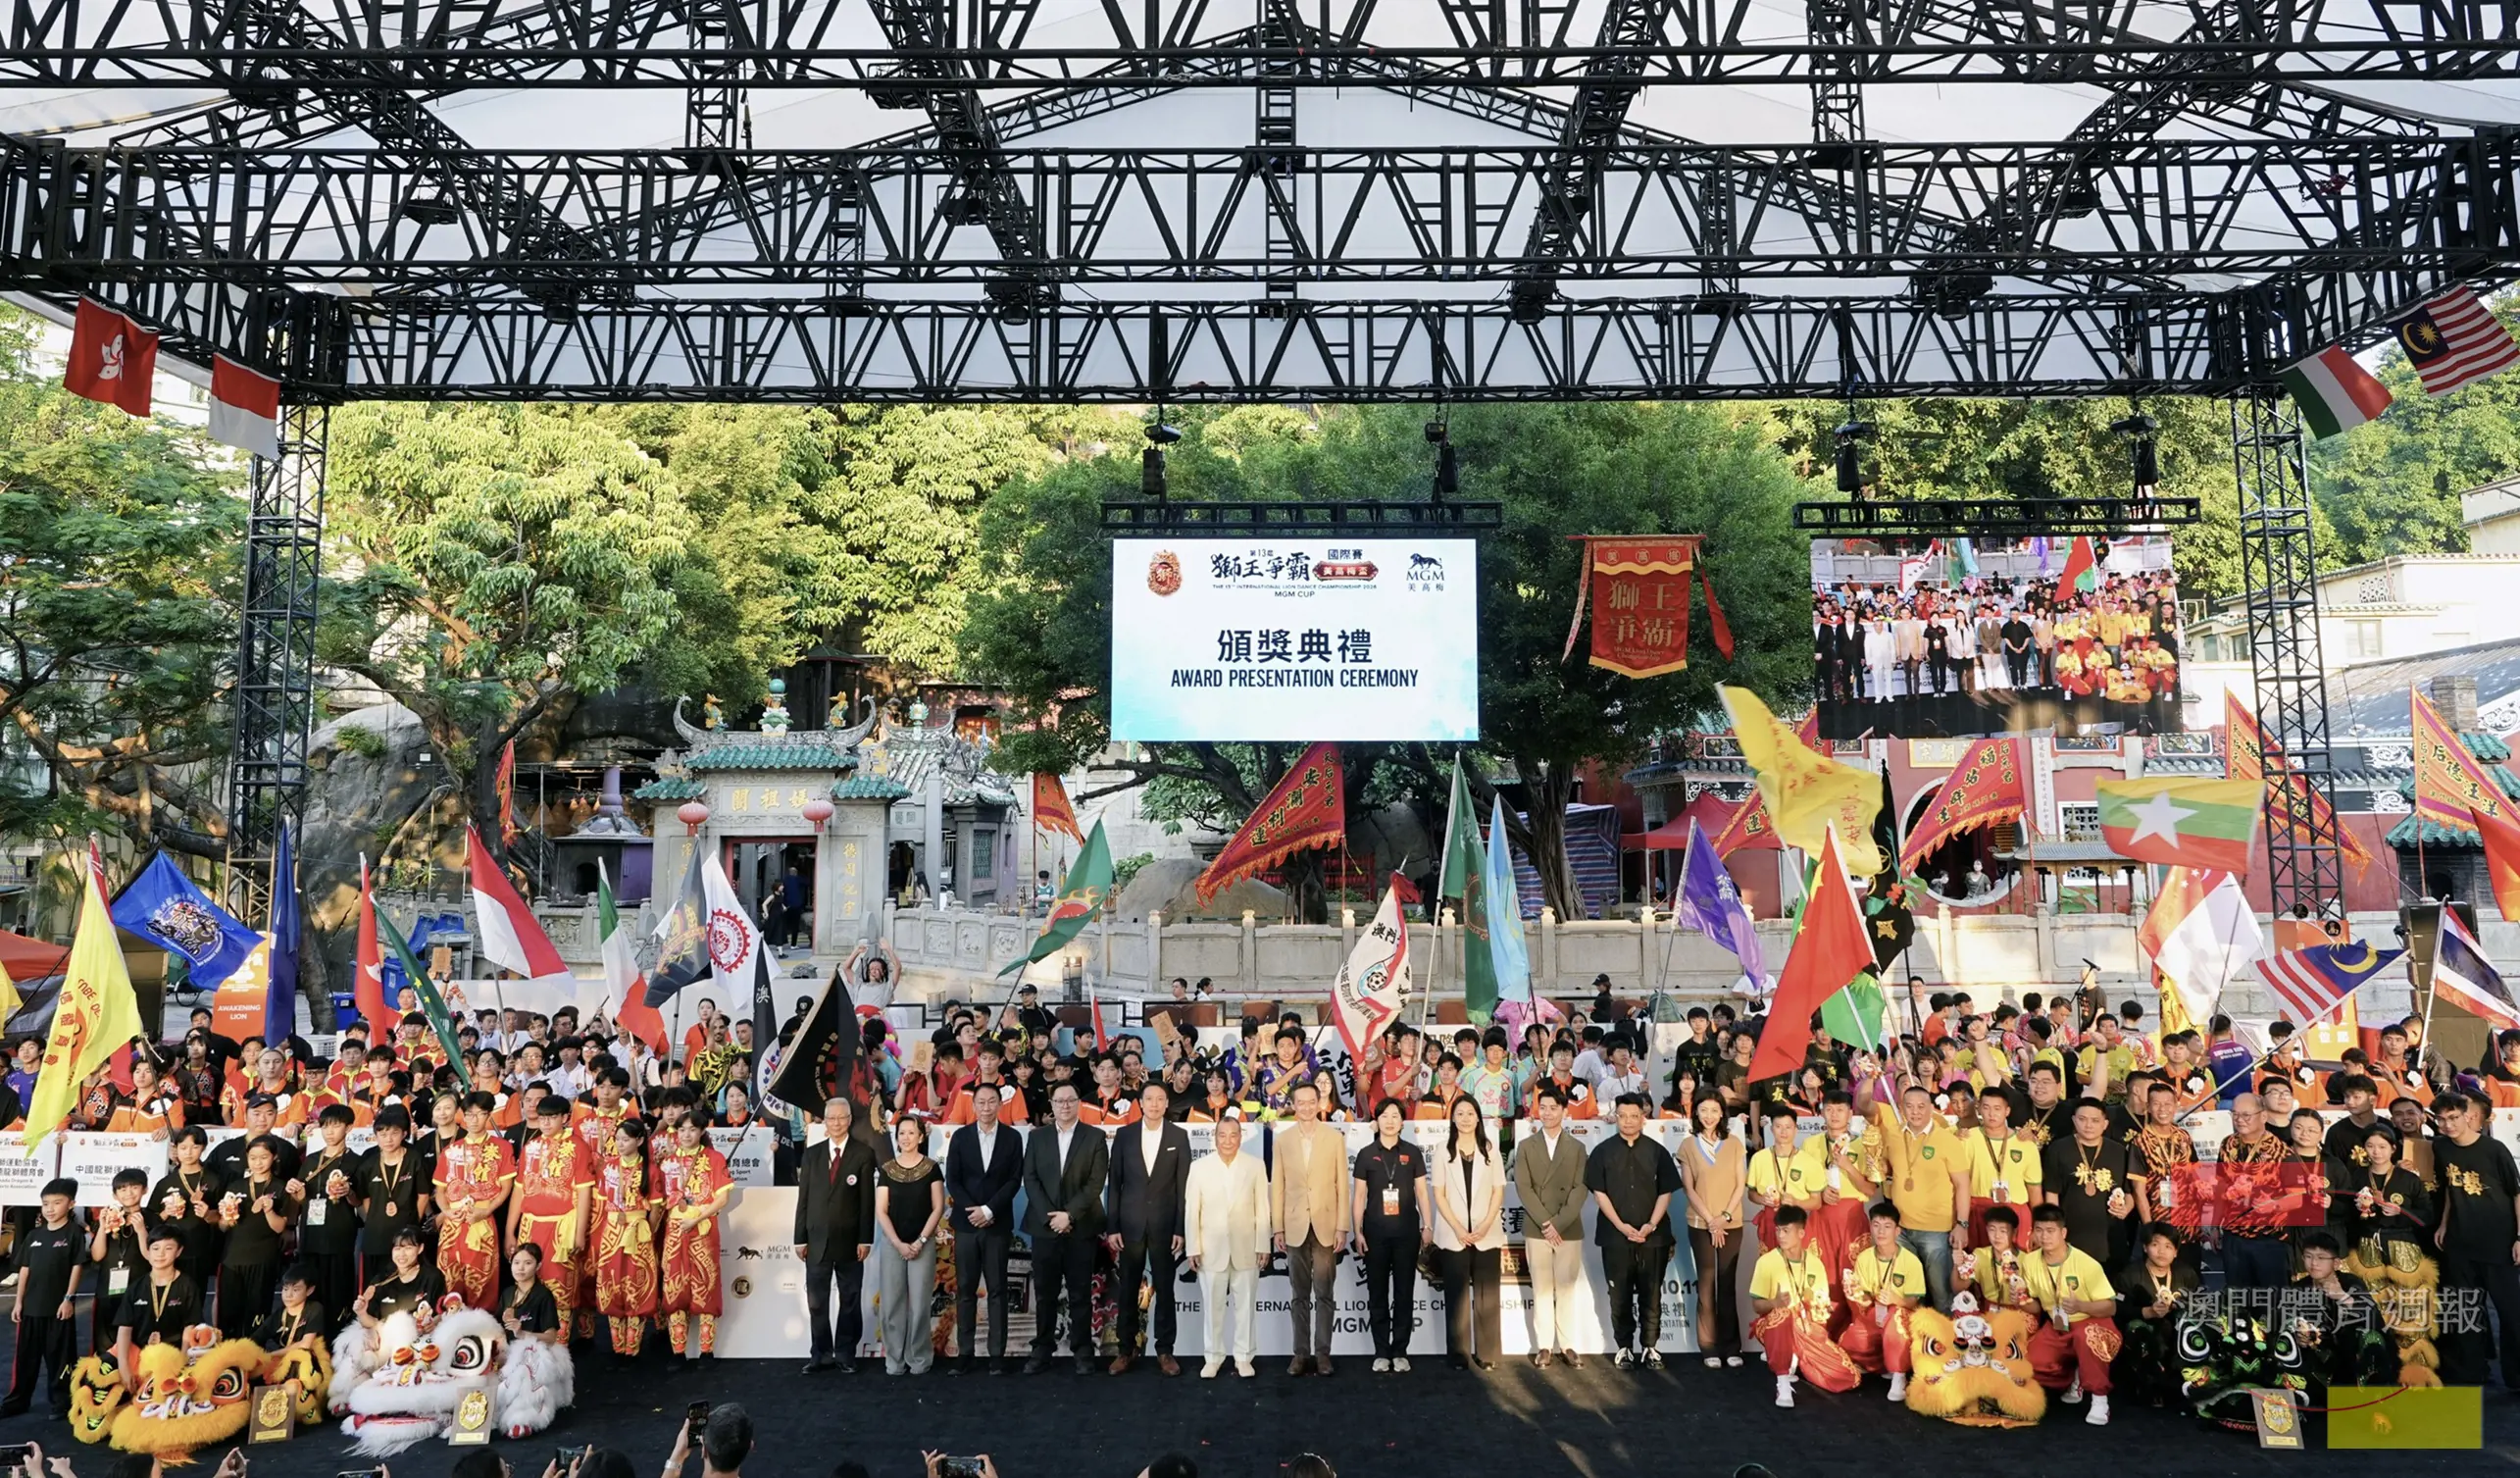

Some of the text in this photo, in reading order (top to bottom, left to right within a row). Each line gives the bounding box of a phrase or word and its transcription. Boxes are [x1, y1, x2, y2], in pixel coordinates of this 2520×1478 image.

[1328, 548, 1363, 560] 國際賽
[1211, 551, 1310, 583] 獅王爭霸
[1406, 570, 1444, 581] MGM
[1217, 629, 1373, 663] 頒獎典禮
[1171, 669, 1418, 688] AWARD PRESENTATION CEREMONY
[1175, 1301, 1200, 1312] THE
